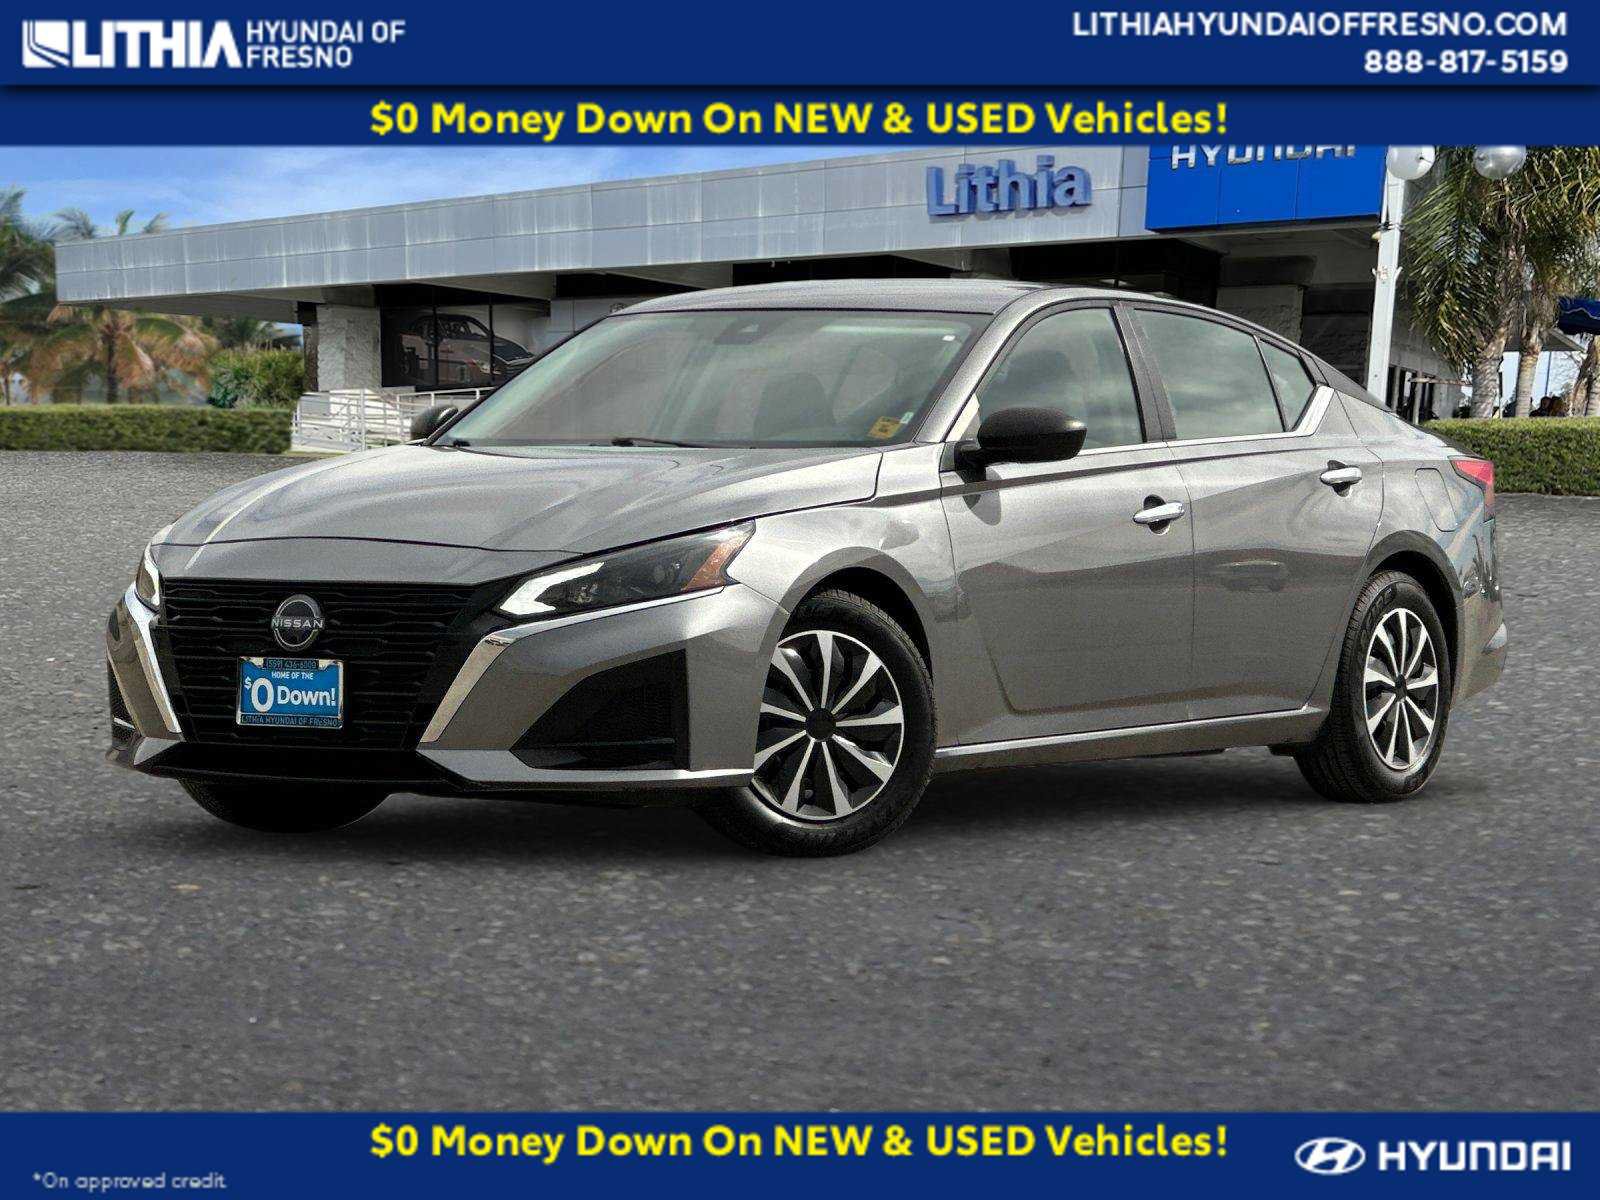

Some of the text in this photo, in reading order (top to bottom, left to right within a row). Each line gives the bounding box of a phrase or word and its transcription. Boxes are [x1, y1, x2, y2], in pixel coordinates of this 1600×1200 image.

[926, 155, 1092, 216] Lithia
[271, 618, 324, 629] NISSAN
[271, 671, 290, 679] HOME
[301, 672, 314, 680] THE
[277, 685, 336, 707] Down!
